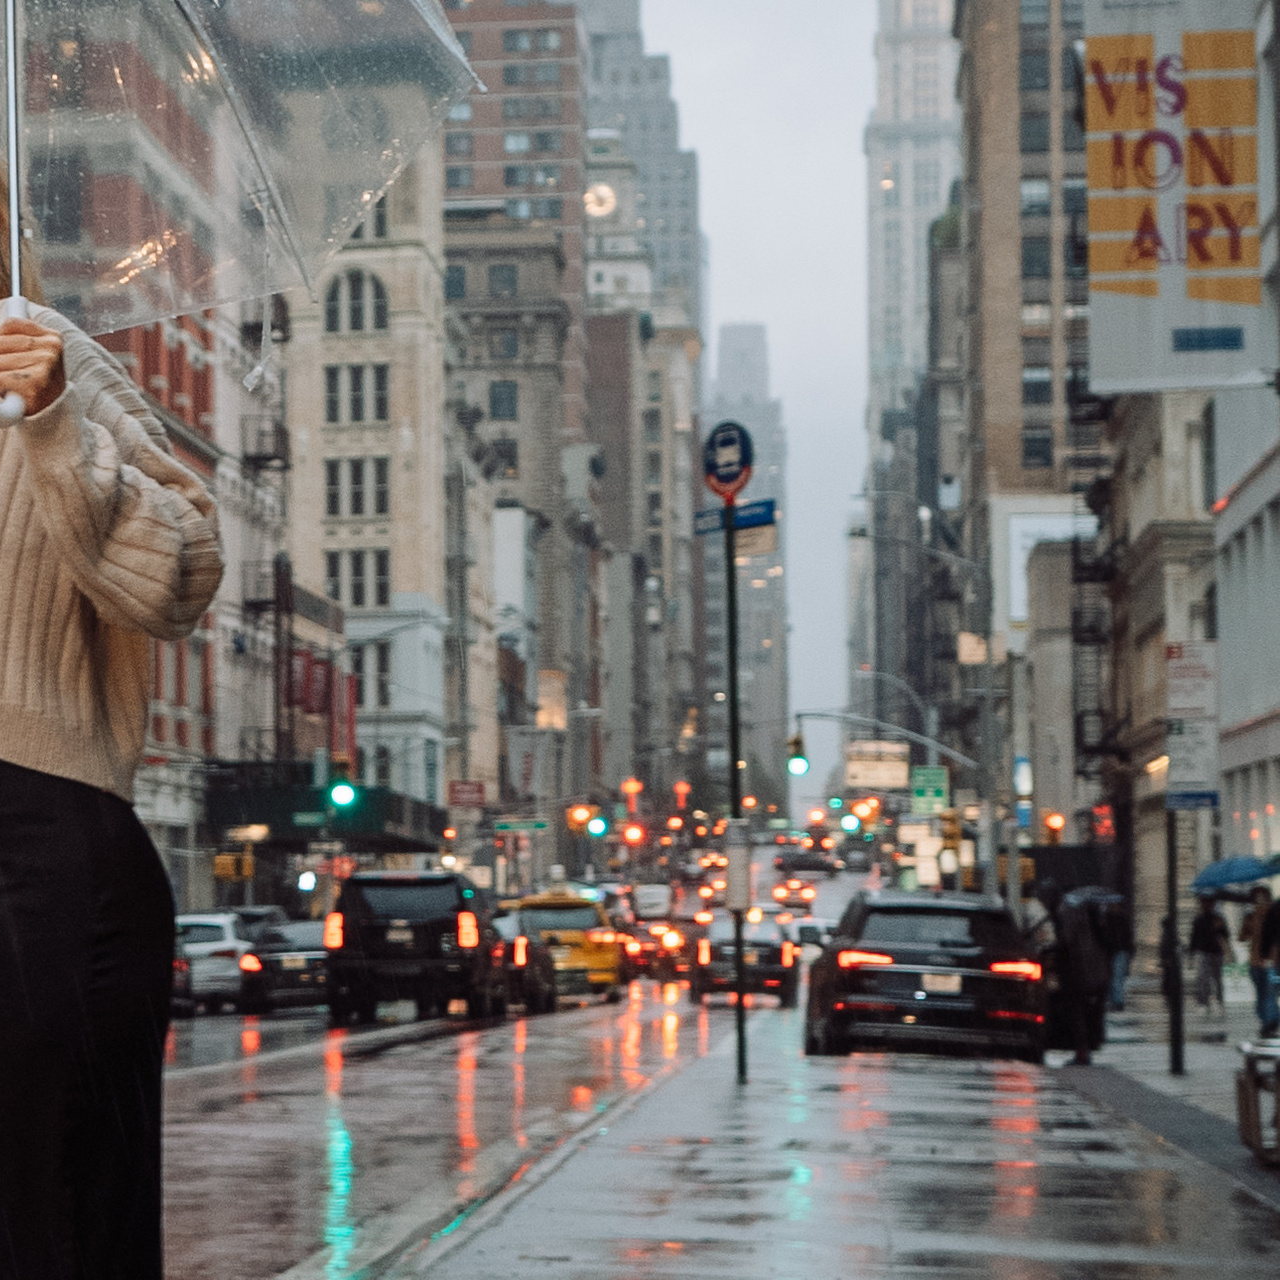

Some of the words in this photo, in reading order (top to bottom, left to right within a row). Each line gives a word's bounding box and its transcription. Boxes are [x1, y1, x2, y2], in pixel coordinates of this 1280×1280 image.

[1090, 53, 1189, 117] VIS
[1111, 127, 1234, 191] ION
[1125, 200, 1257, 266] ARY
